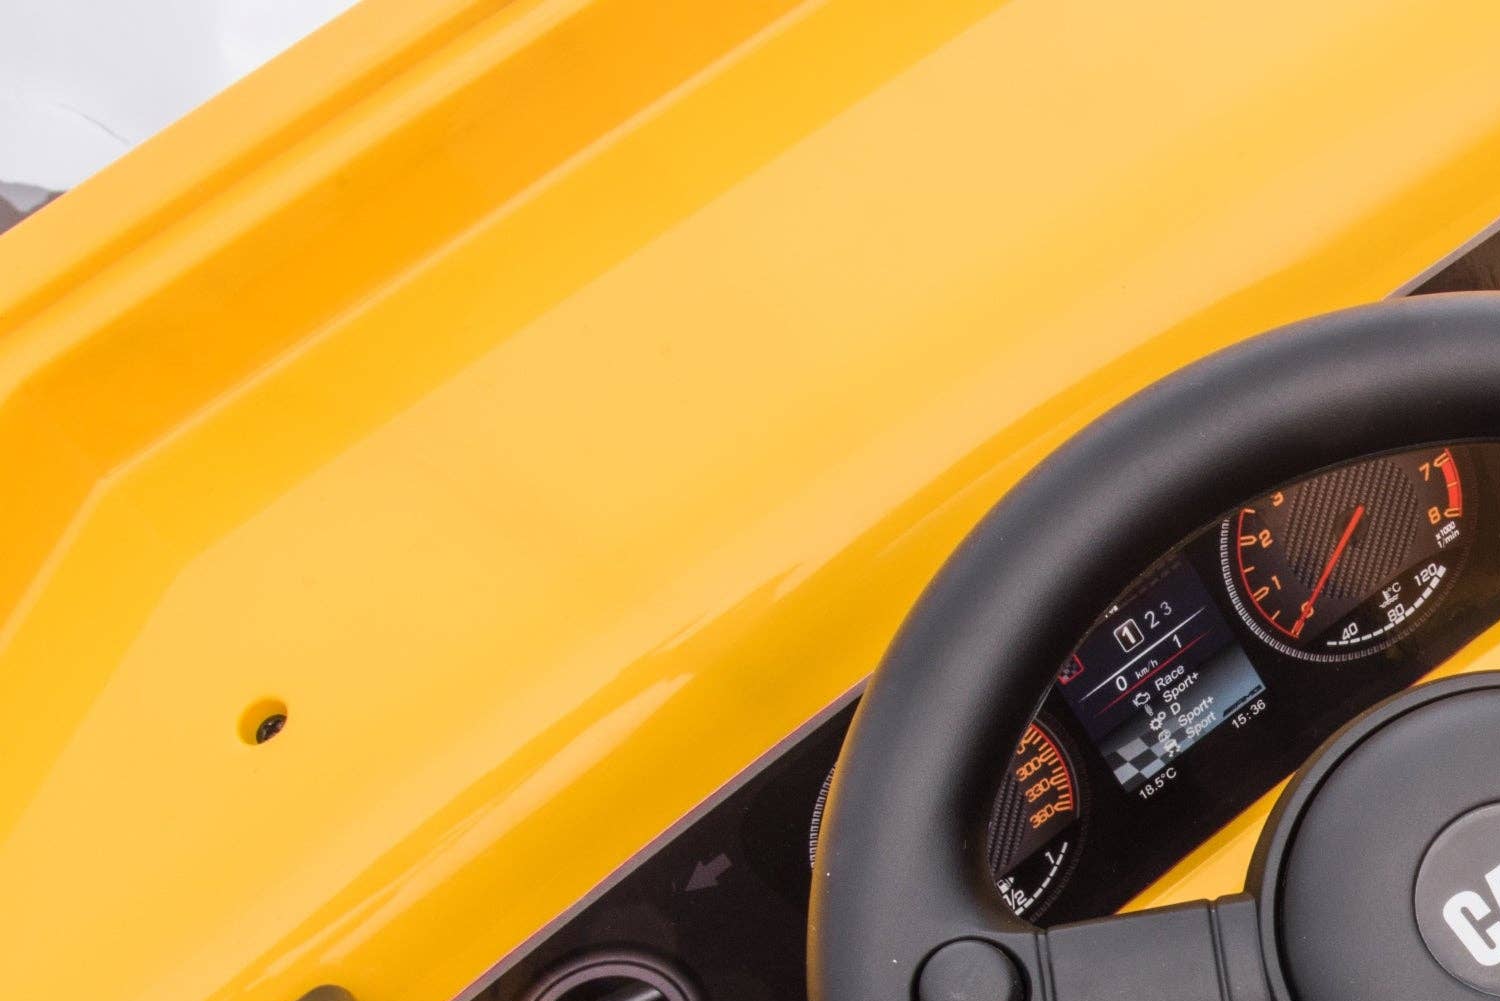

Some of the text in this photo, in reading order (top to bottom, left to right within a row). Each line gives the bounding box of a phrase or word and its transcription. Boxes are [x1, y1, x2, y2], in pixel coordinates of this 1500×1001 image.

[1419, 462, 1431, 481] 7
[1427, 506, 1441, 524] 8
[1258, 529, 1274, 548] 2
[1271, 575, 1282, 590] 1
[1414, 562, 1438, 586] 120
[1122, 601, 1173, 644] 1 2 3
[1387, 603, 1405, 622] 80
[1172, 633, 1183, 648] 1
[1342, 622, 1359, 641] 40
[1115, 658, 1158, 692] 0 km/h
[1154, 664, 1185, 691] Race
[1163, 671, 1200, 703] Sport+
[1170, 702, 1181, 715] D
[1178, 695, 1214, 727] Sport+
[1185, 712, 1217, 739] Sport
[1016, 756, 1041, 781] 300
[1025, 778, 1050, 802] 330
[1138, 767, 1177, 799] 18.5°C
[1045, 851, 1055, 864] 1
[1002, 889, 1027, 910] 1/2
